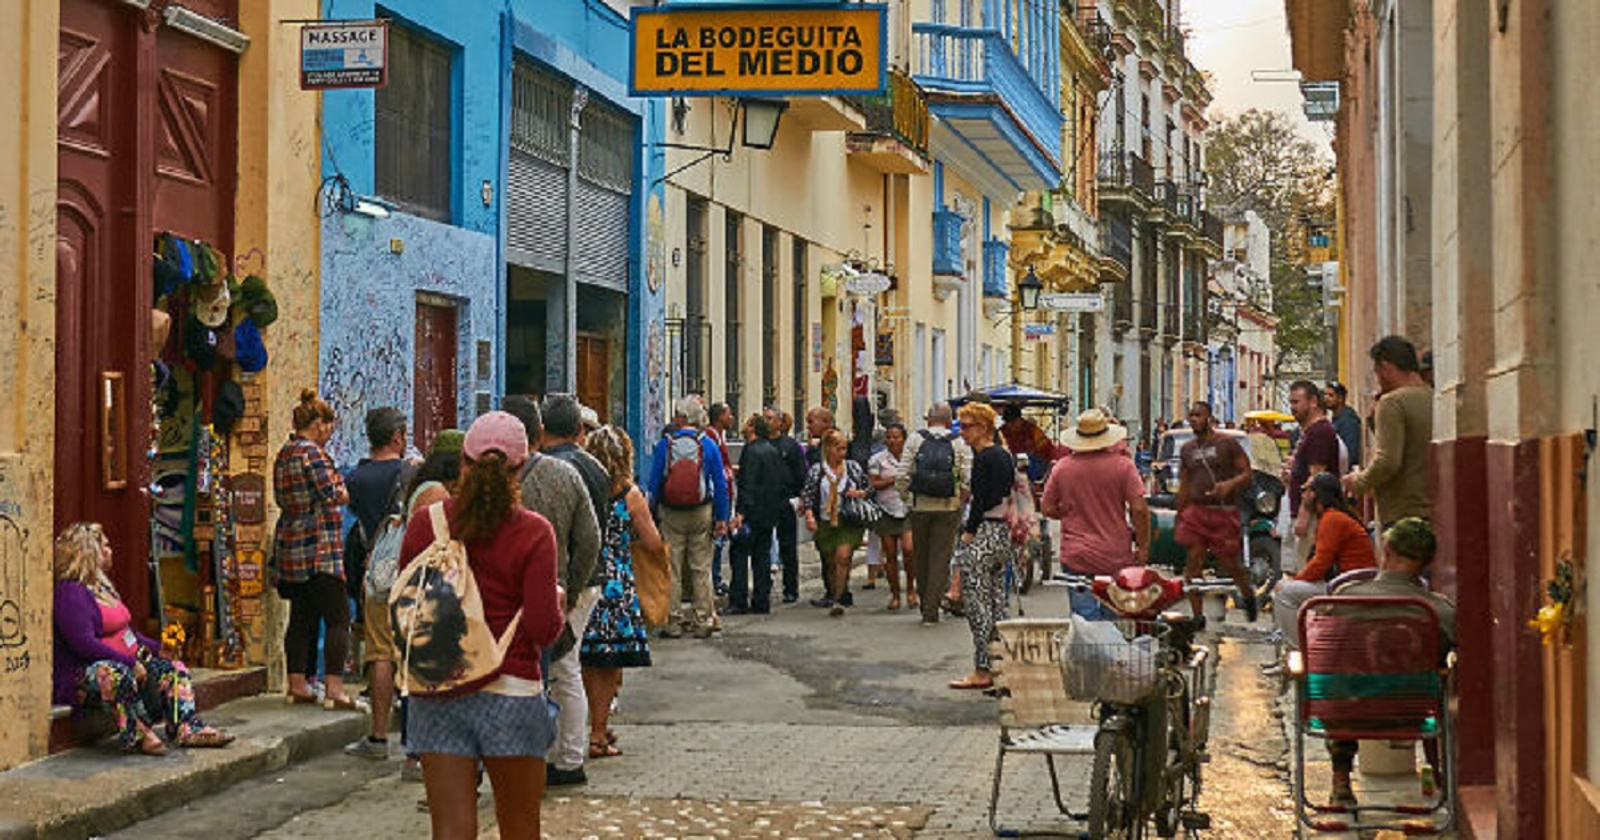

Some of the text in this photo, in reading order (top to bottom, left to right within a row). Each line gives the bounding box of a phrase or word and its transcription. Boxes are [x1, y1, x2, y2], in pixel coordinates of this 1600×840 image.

[308, 29, 377, 43] MASSAGE
[656, 26, 862, 49] LA BODEGUITA
[656, 50, 864, 77] DEL MEDIO
